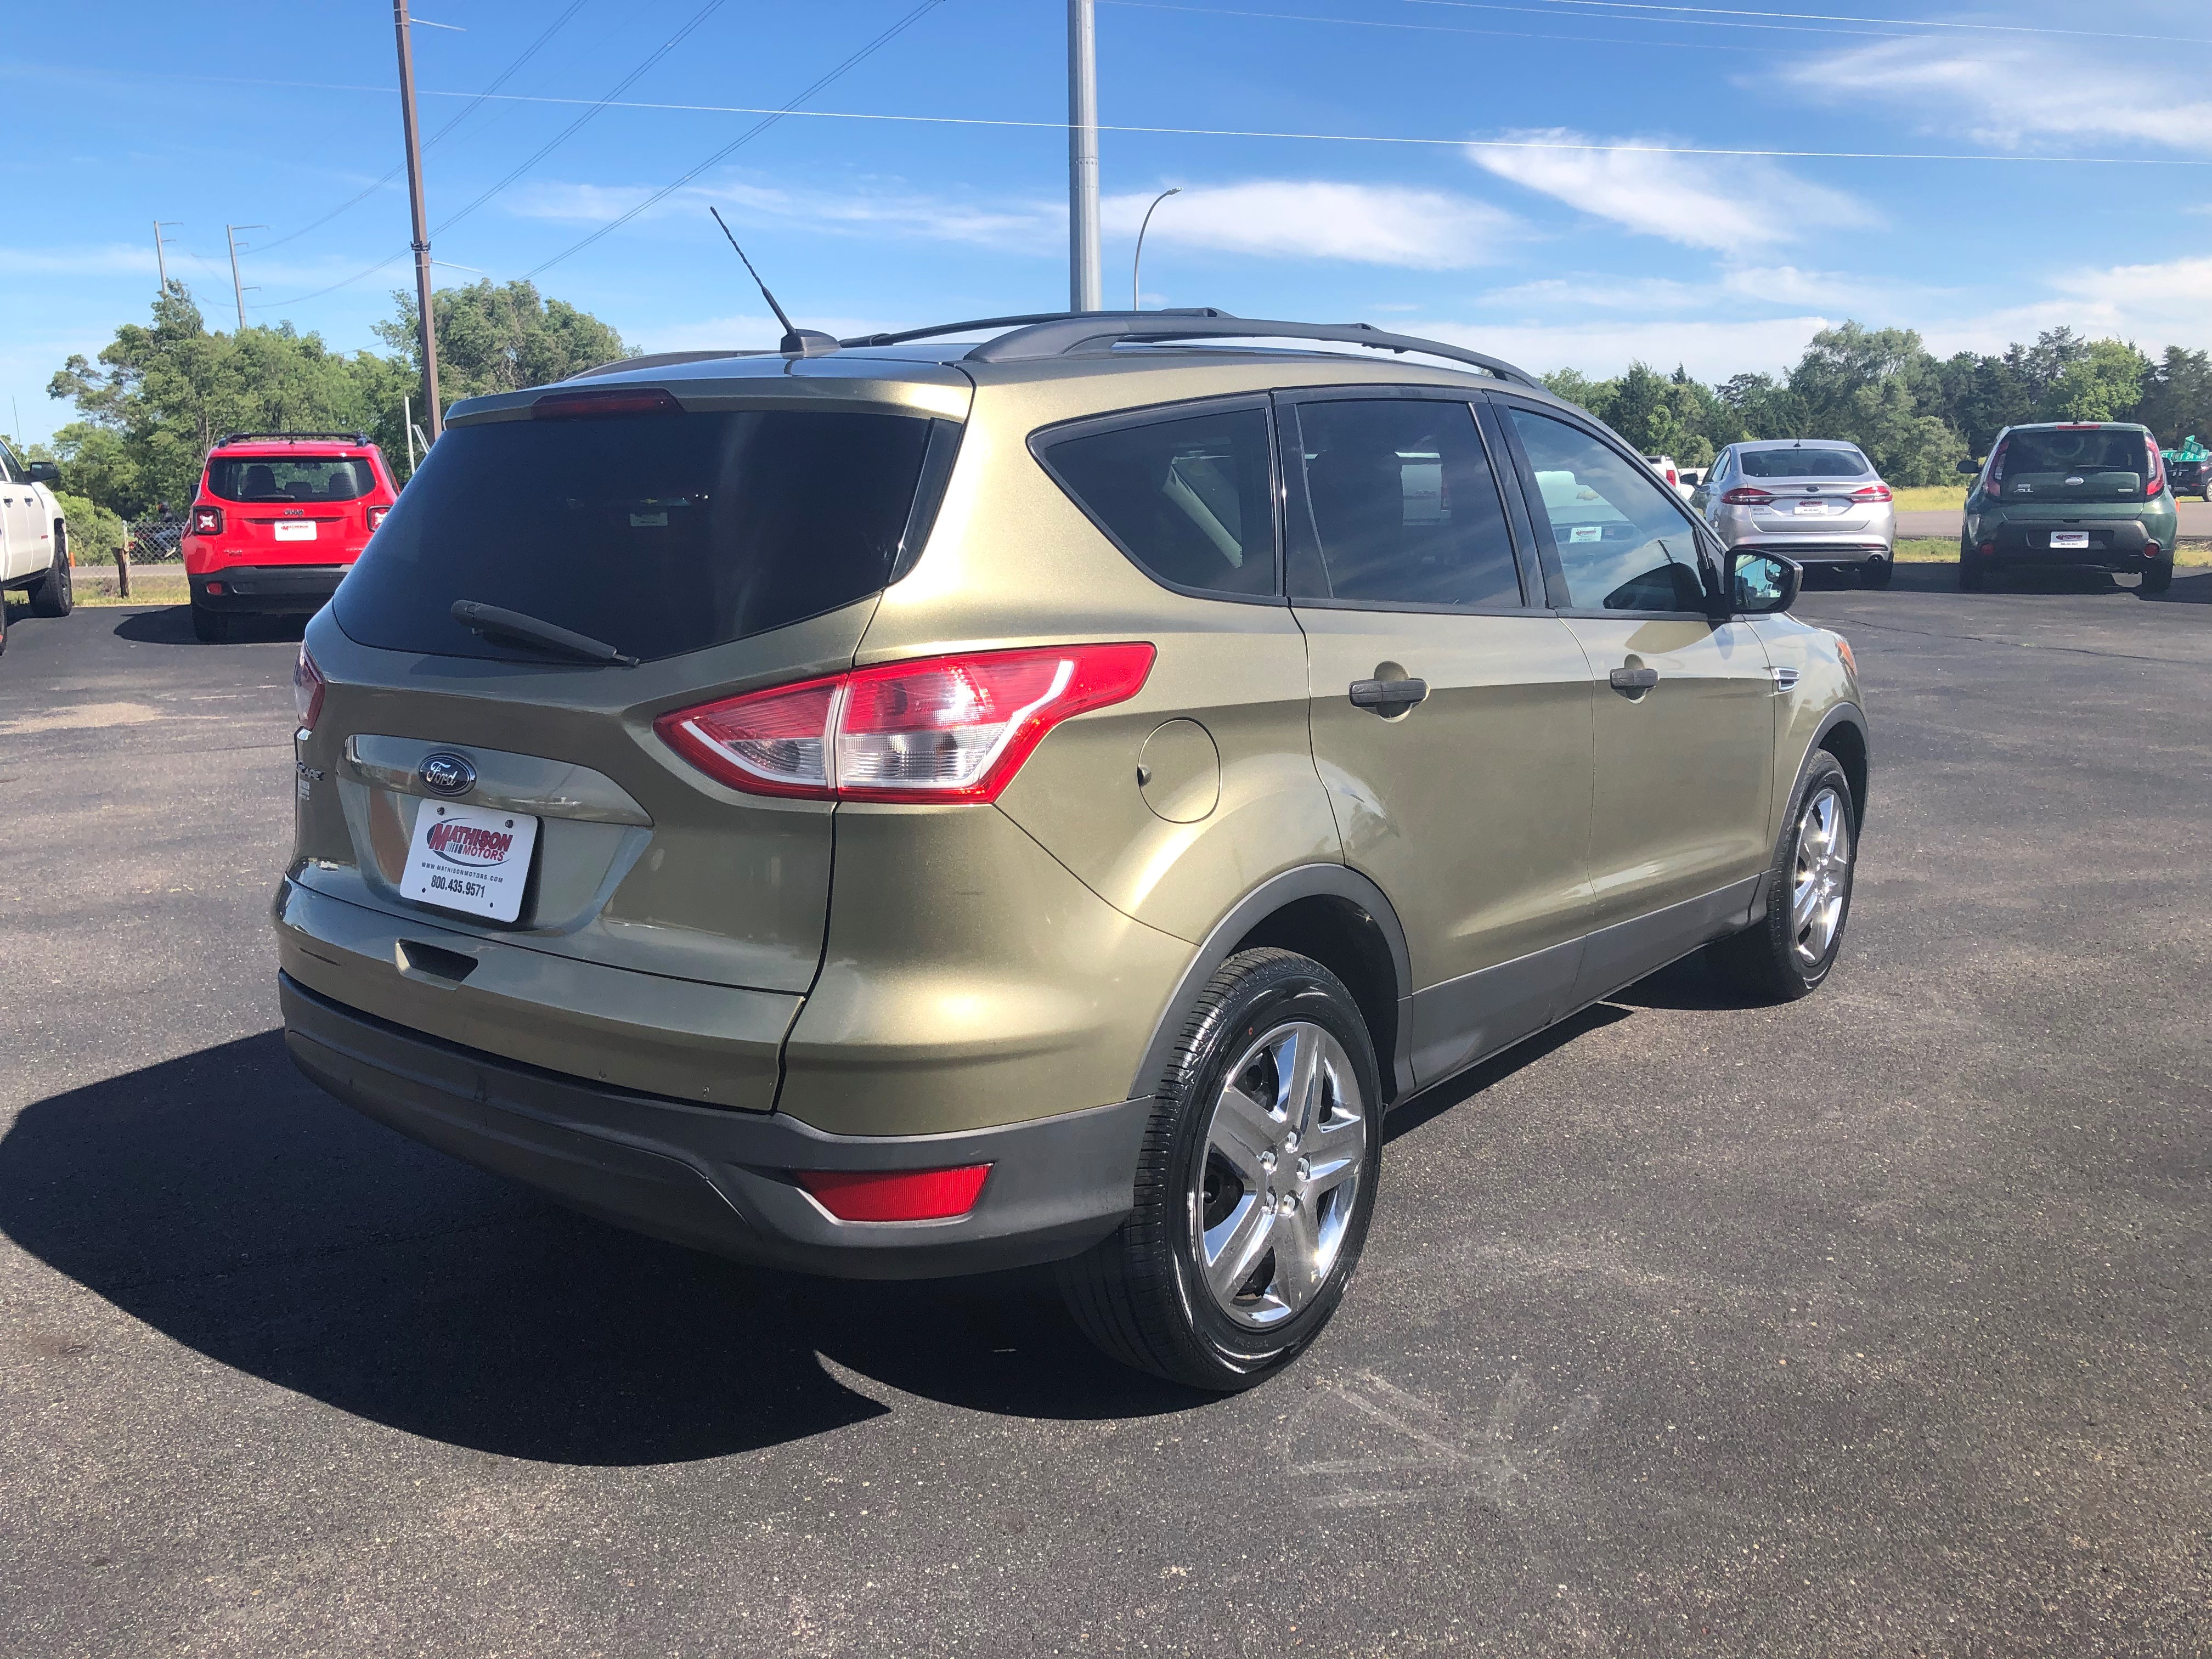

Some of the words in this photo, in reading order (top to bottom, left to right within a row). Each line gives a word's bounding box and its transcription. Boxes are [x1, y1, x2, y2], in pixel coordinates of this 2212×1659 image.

[2186, 452, 2194, 460] 24
[426, 761, 458, 786] Ford
[428, 823, 513, 851] MATHISON
[462, 845, 505, 861] MOTORS
[431, 874, 486, 898] 800.435.9571
